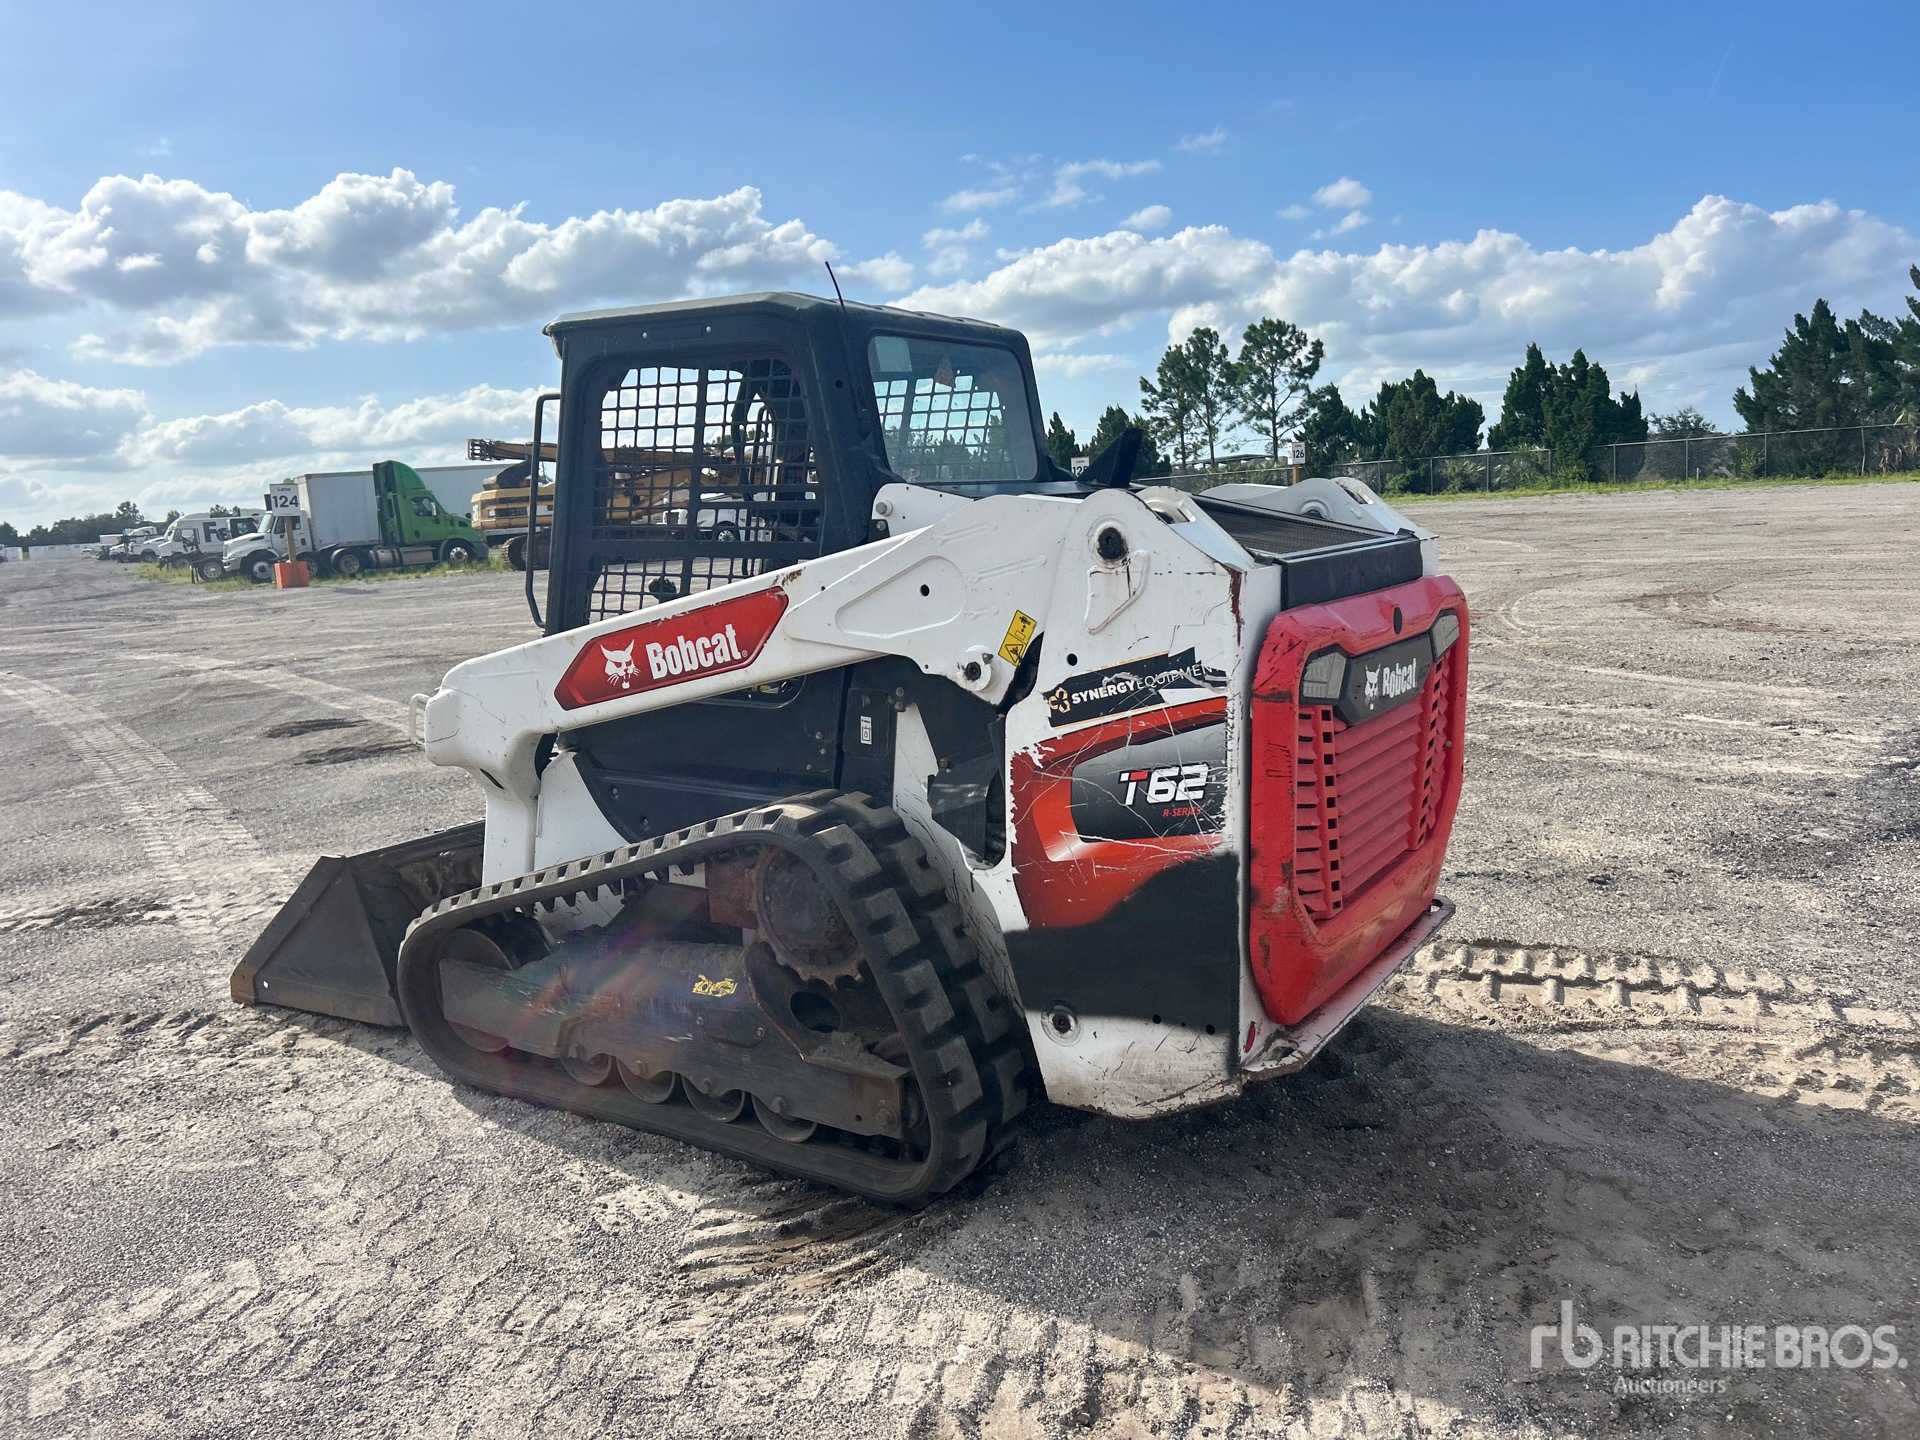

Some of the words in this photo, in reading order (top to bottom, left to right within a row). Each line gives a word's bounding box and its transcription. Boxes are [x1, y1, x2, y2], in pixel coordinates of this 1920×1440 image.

[1293, 449, 1305, 459] 126
[272, 495, 299, 508] 124
[645, 623, 742, 680] Bobcat
[1119, 763, 1209, 806] T62
[1162, 806, 1201, 817] R-SERIES
